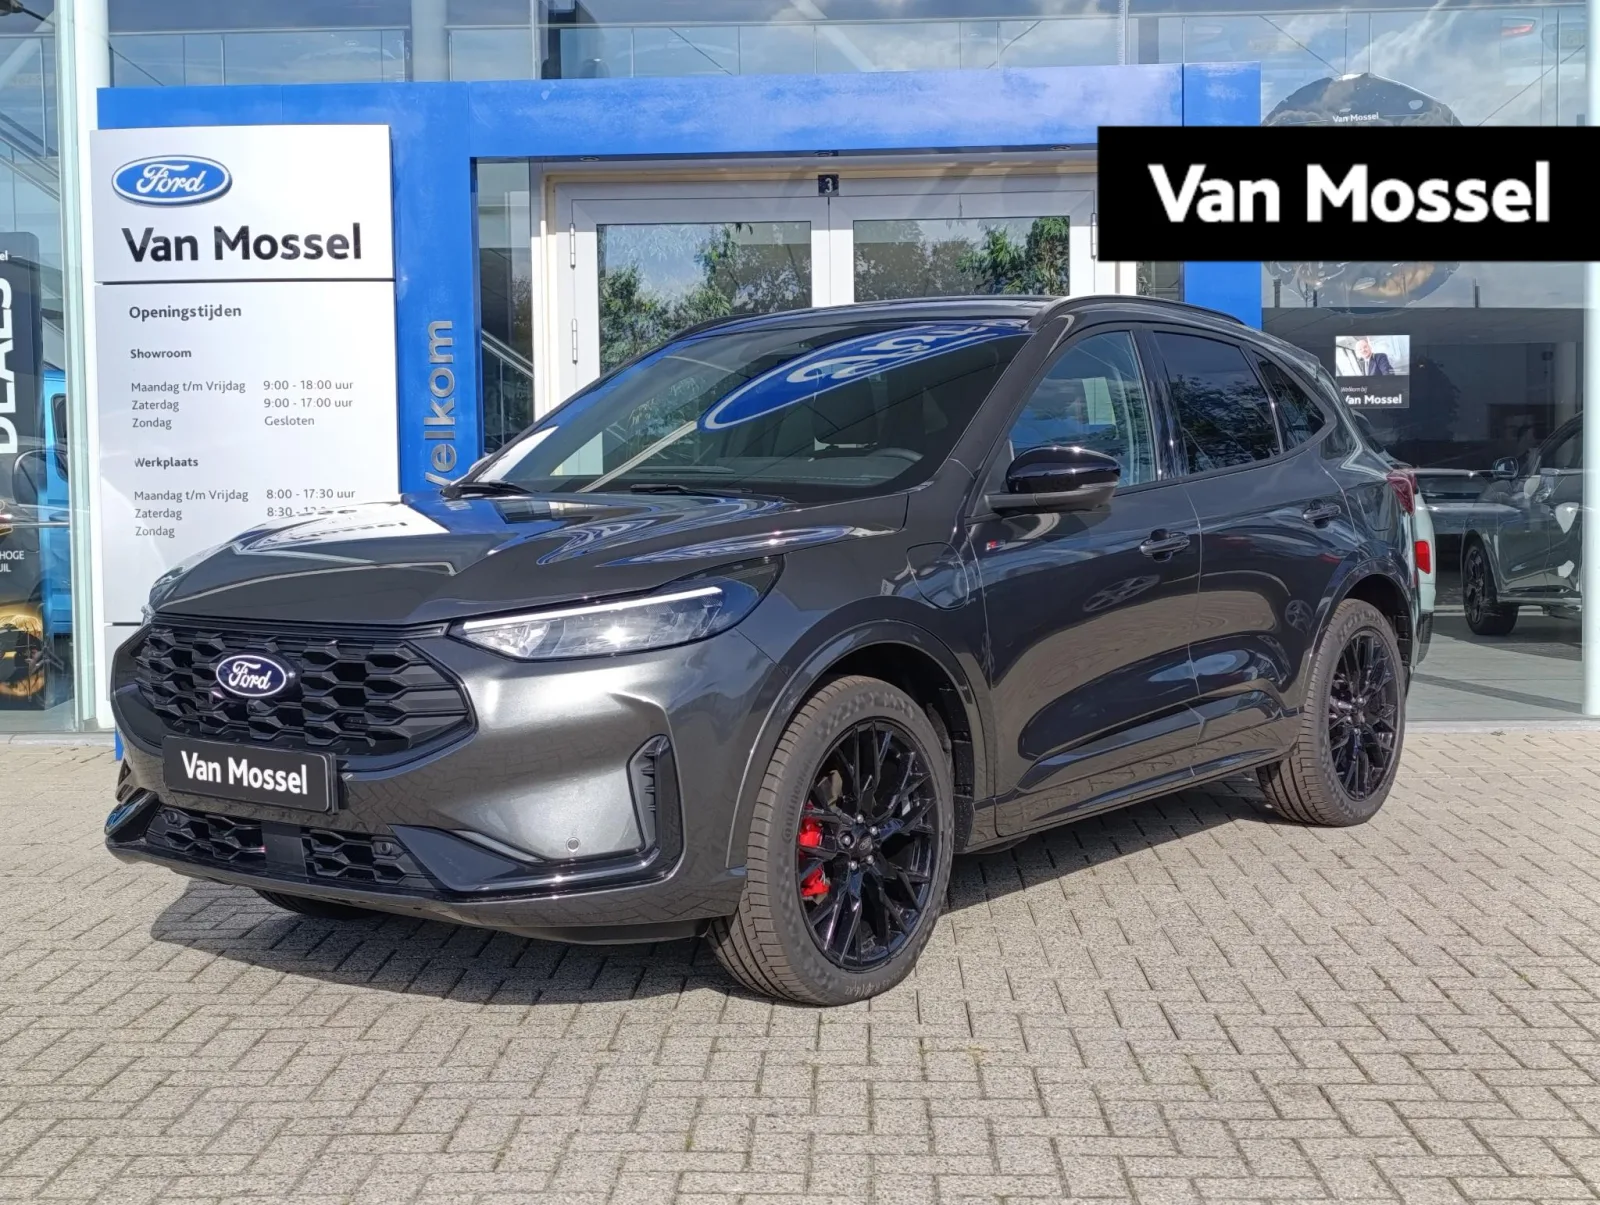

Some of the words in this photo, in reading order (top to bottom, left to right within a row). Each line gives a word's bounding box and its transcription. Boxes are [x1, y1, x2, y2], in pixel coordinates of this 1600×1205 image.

[1332, 115, 1348, 123] Van
[1350, 111, 1379, 121] Mossel
[136, 163, 206, 194] Ford
[825, 177, 834, 193] 3
[121, 227, 199, 262] Van
[213, 222, 361, 261] Mossel
[129, 304, 242, 322] Openingstijden
[130, 348, 192, 359] Showroom
[131, 381, 180, 395] Maandag
[182, 381, 203, 392] t/m
[205, 380, 246, 394] Vrijdag
[263, 380, 289, 391] 9:00
[300, 379, 332, 390] 18:00
[335, 381, 354, 389] uur
[131, 399, 180, 412] Zaterdag
[263, 397, 290, 408] 9:00
[300, 397, 332, 408] 17:00
[334, 399, 353, 407] uur
[1364, 394, 1402, 404] Mossel
[132, 417, 173, 430] Zondag
[264, 415, 315, 426] Gesloten
[134, 457, 199, 470] Werkplaats
[134, 490, 183, 503] Maandag
[185, 489, 206, 500] t/m
[208, 489, 249, 503] Vrijdag
[266, 489, 292, 500] 8:00
[303, 488, 334, 499] 17:30
[337, 490, 356, 498] uur
[135, 508, 183, 521] Zaterdag
[267, 506, 293, 517] 8:30
[135, 525, 175, 539] Zondag
[228, 661, 272, 690] Ford
[181, 751, 222, 783] Van
[228, 756, 308, 795] Mossel
